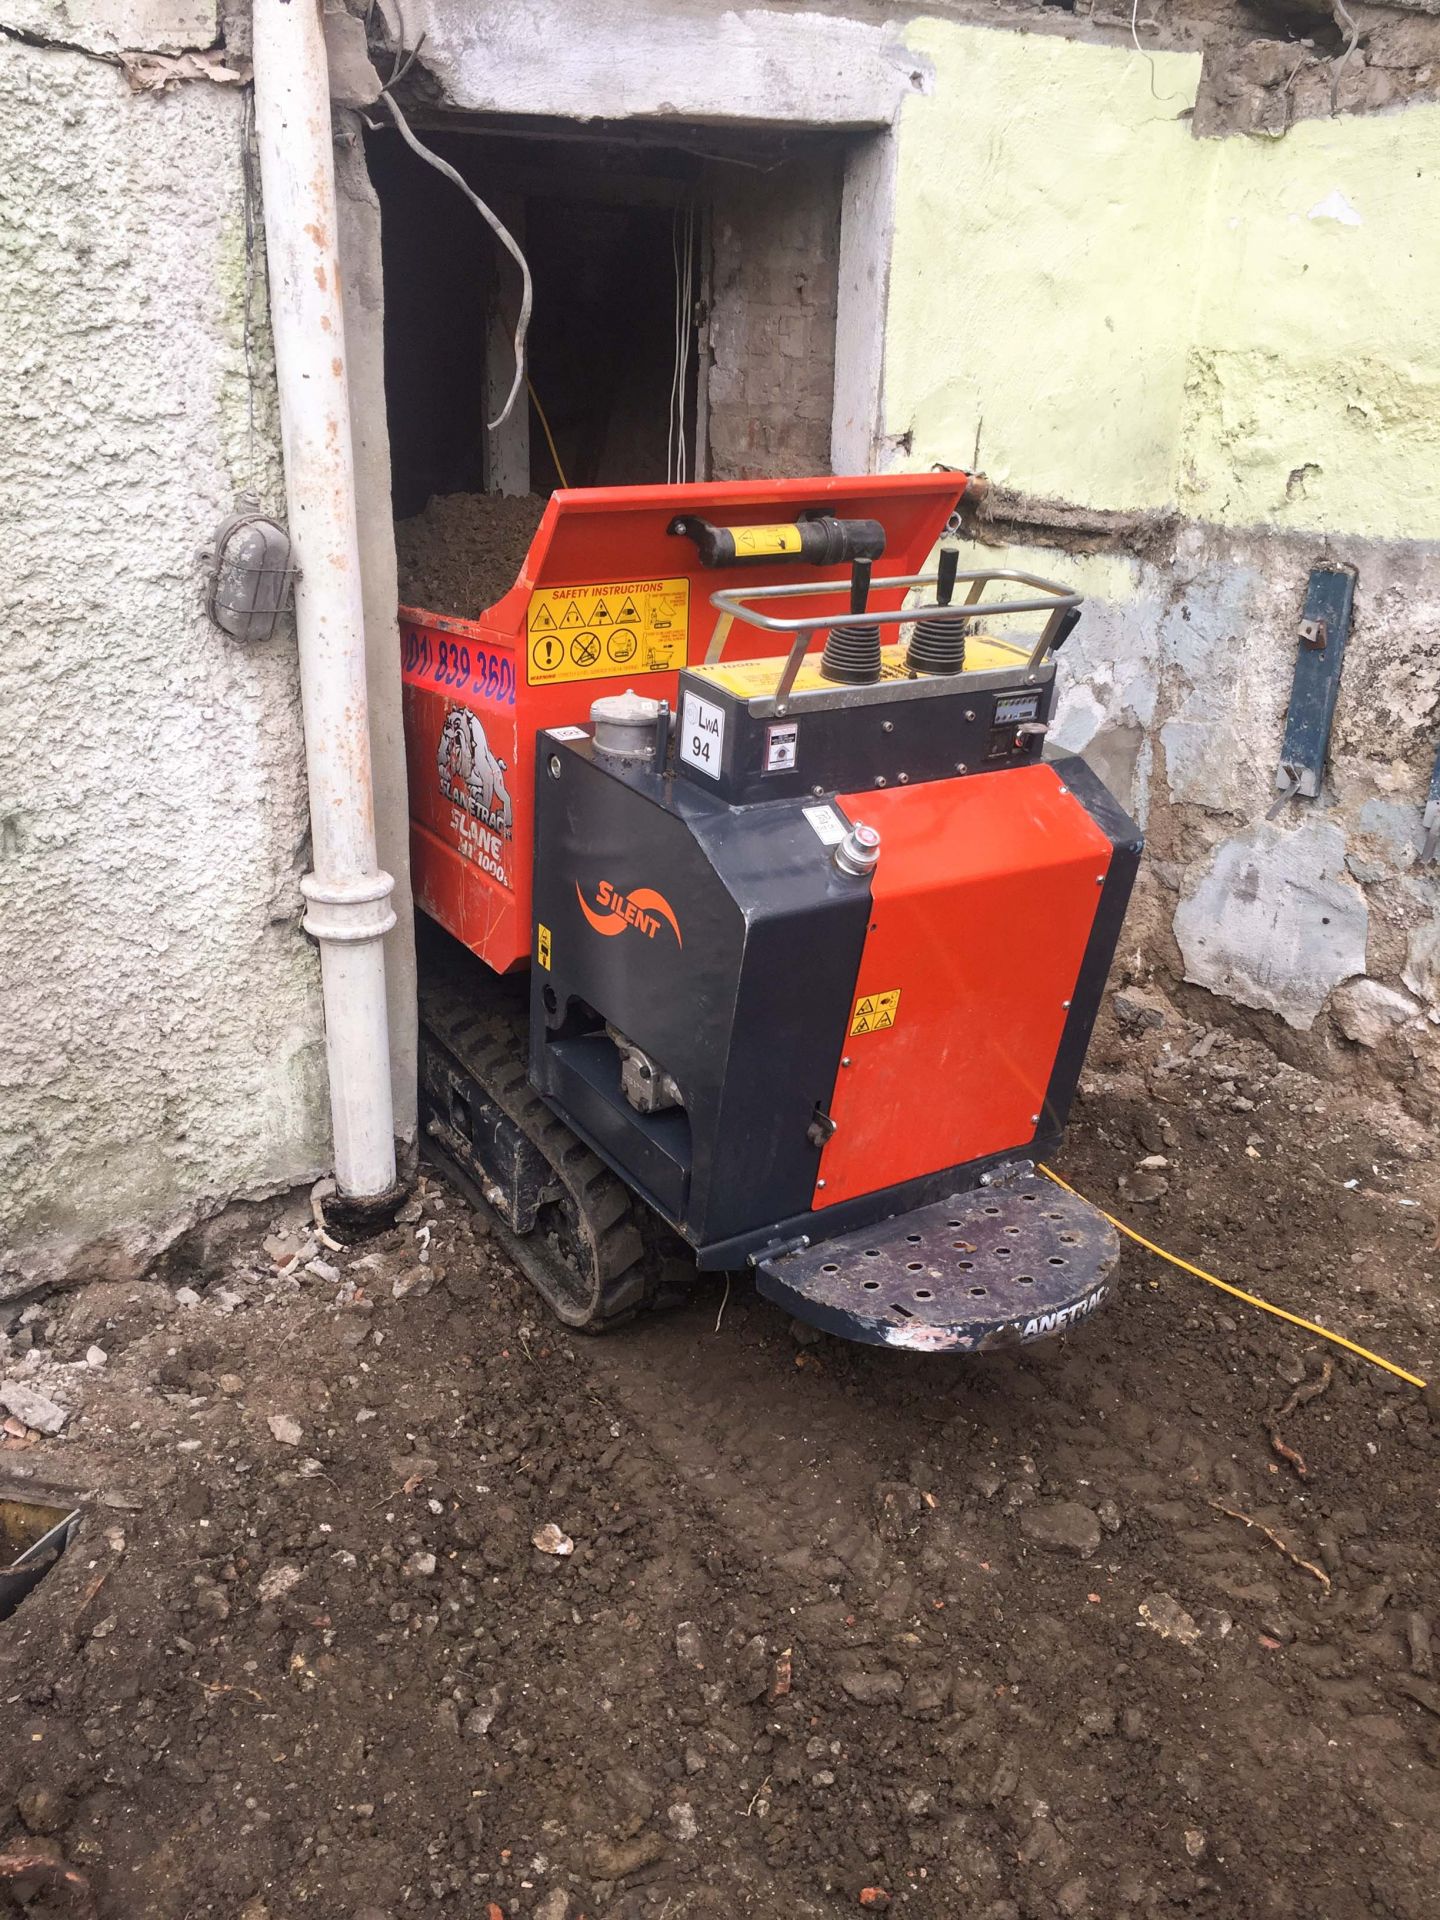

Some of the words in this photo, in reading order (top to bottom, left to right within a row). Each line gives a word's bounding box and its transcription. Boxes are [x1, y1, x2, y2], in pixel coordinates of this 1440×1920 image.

[552, 588, 589, 600] SAFETY
[591, 582, 664, 597] INSTRUCTIONS
[434, 640, 471, 688] 839
[692, 736, 710, 762] 94
[450, 808, 503, 861] SLANE
[595, 880, 661, 939] SILENT
